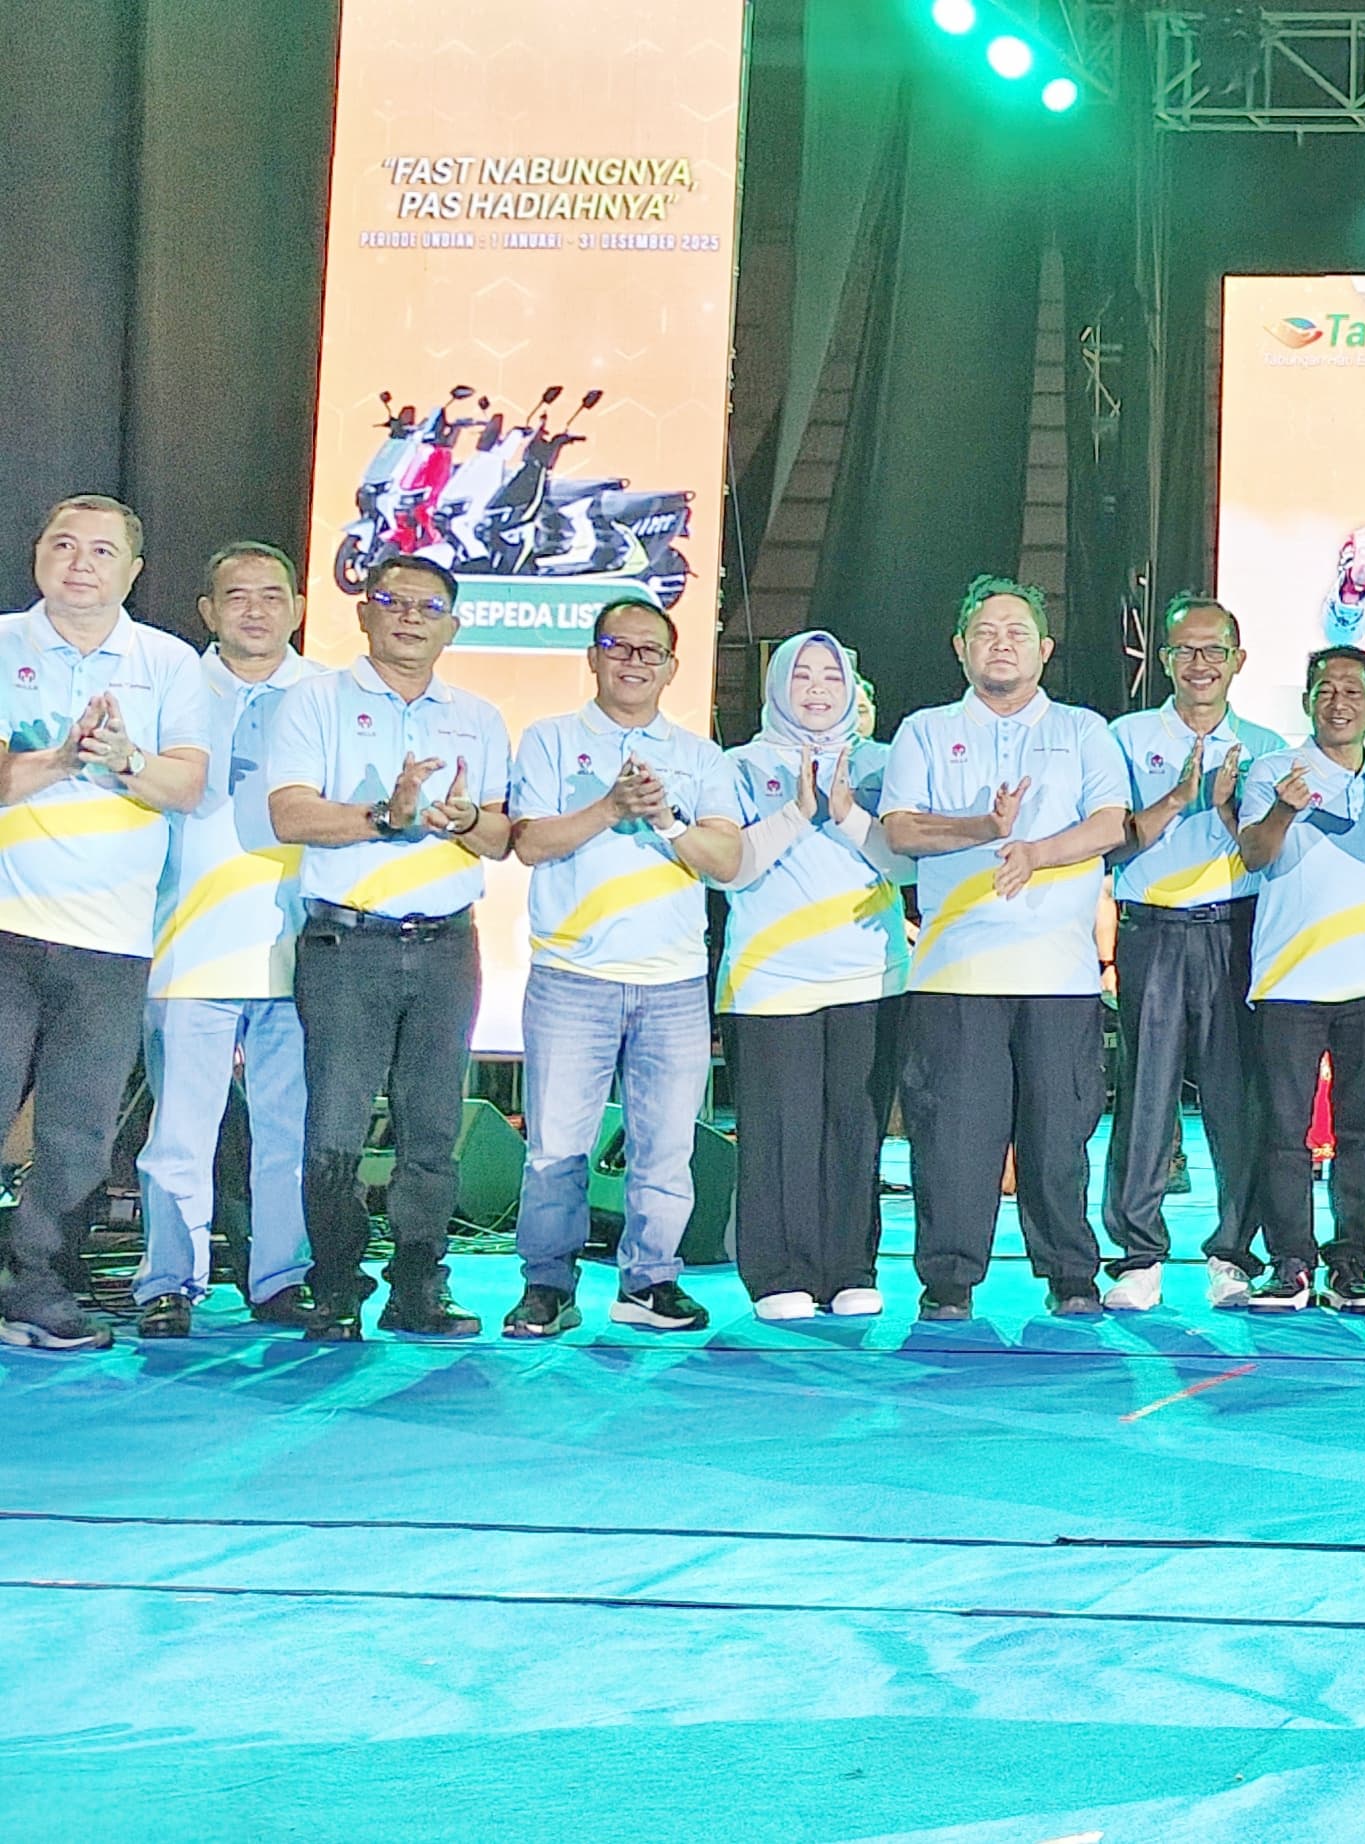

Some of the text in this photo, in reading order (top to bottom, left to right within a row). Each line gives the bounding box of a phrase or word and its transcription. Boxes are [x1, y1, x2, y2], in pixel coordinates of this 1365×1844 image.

[479, 158, 697, 190] NABUNGNYA,
[399, 191, 462, 219] PAS
[360, 232, 417, 248] PERIODE
[421, 232, 474, 249] UNDIAN
[503, 233, 562, 249] JANUARI
[600, 234, 675, 250] DESEMBER
[681, 234, 720, 250] 2025
[459, 602, 554, 628] SEPEDA
